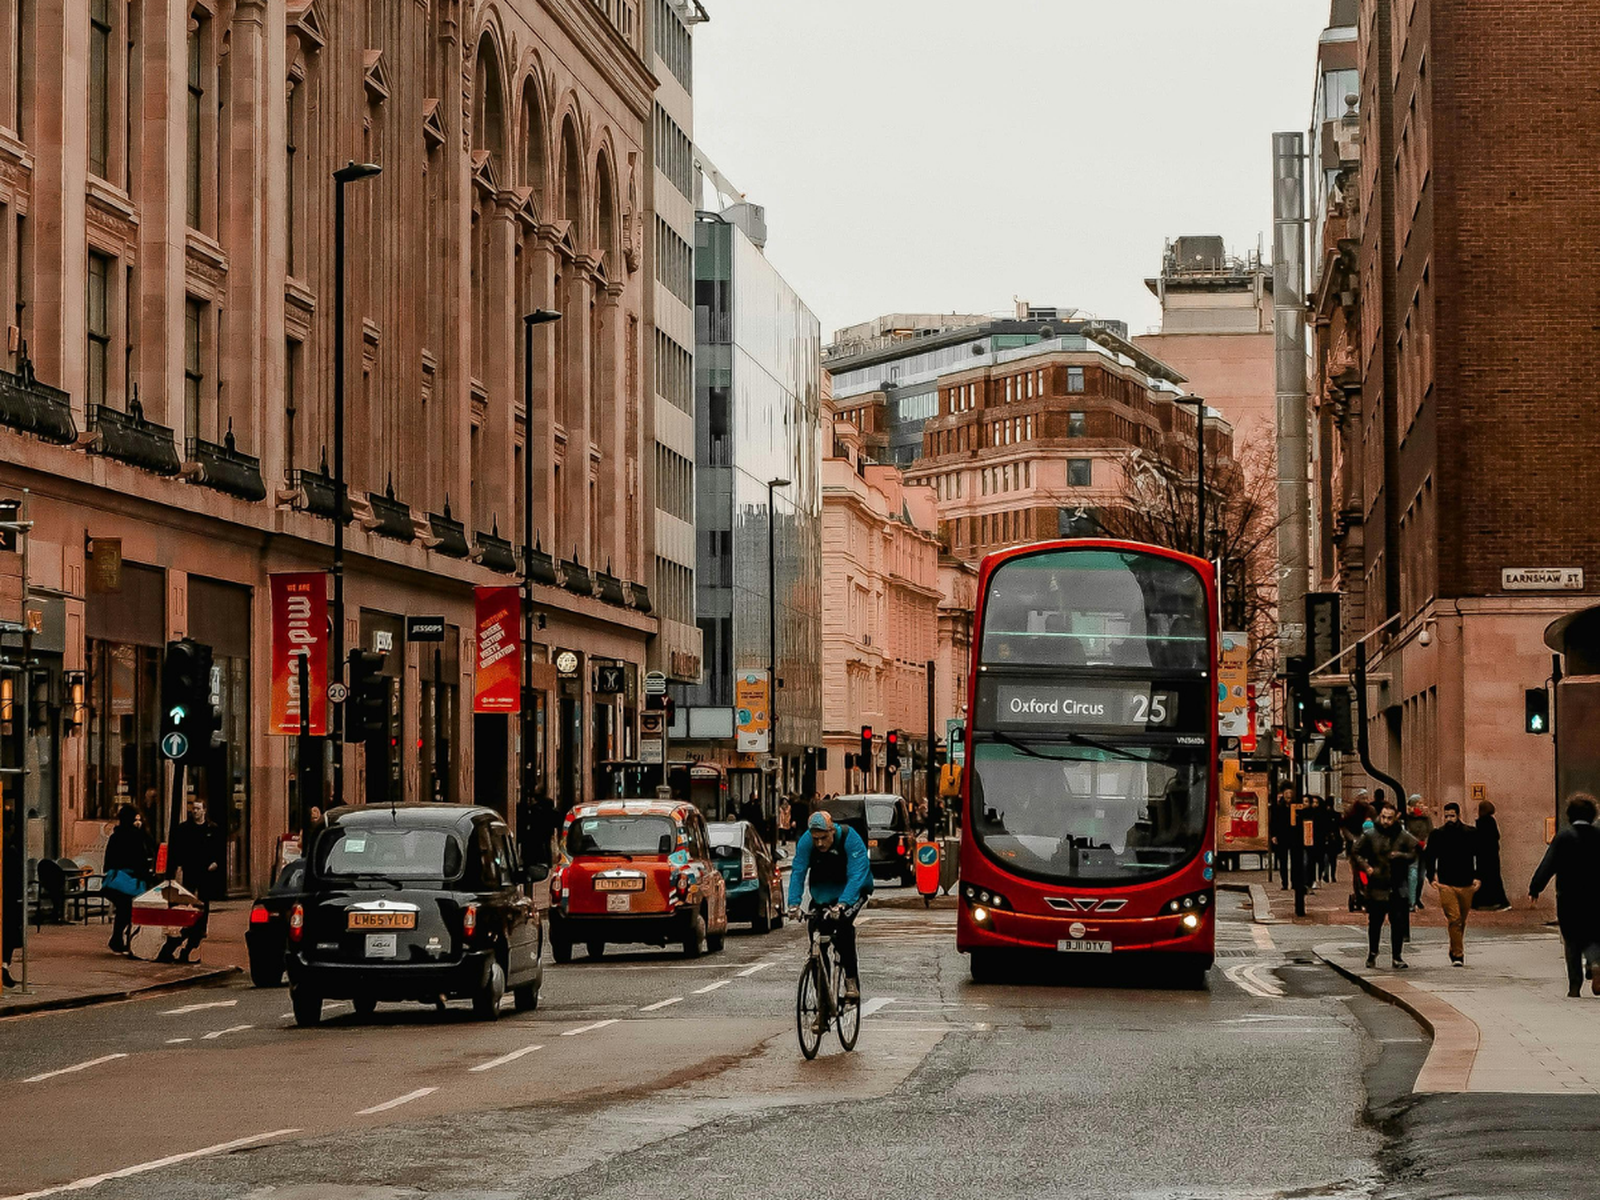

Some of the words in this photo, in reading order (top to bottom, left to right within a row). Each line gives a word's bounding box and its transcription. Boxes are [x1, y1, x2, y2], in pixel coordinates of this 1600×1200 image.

[1506, 574, 1561, 583] EARNSHAW
[286, 584, 297, 592] WE
[411, 624, 443, 633] JESSOPS
[479, 630, 506, 650] HISTORY
[330, 688, 346, 698] 20
[1010, 697, 1058, 714] Oxford
[1062, 699, 1104, 715] Circus
[1131, 694, 1167, 723] 25
[1473, 786, 1483, 798] H
[387, 913, 409, 925] YLO
[1086, 941, 1105, 951] DTV
